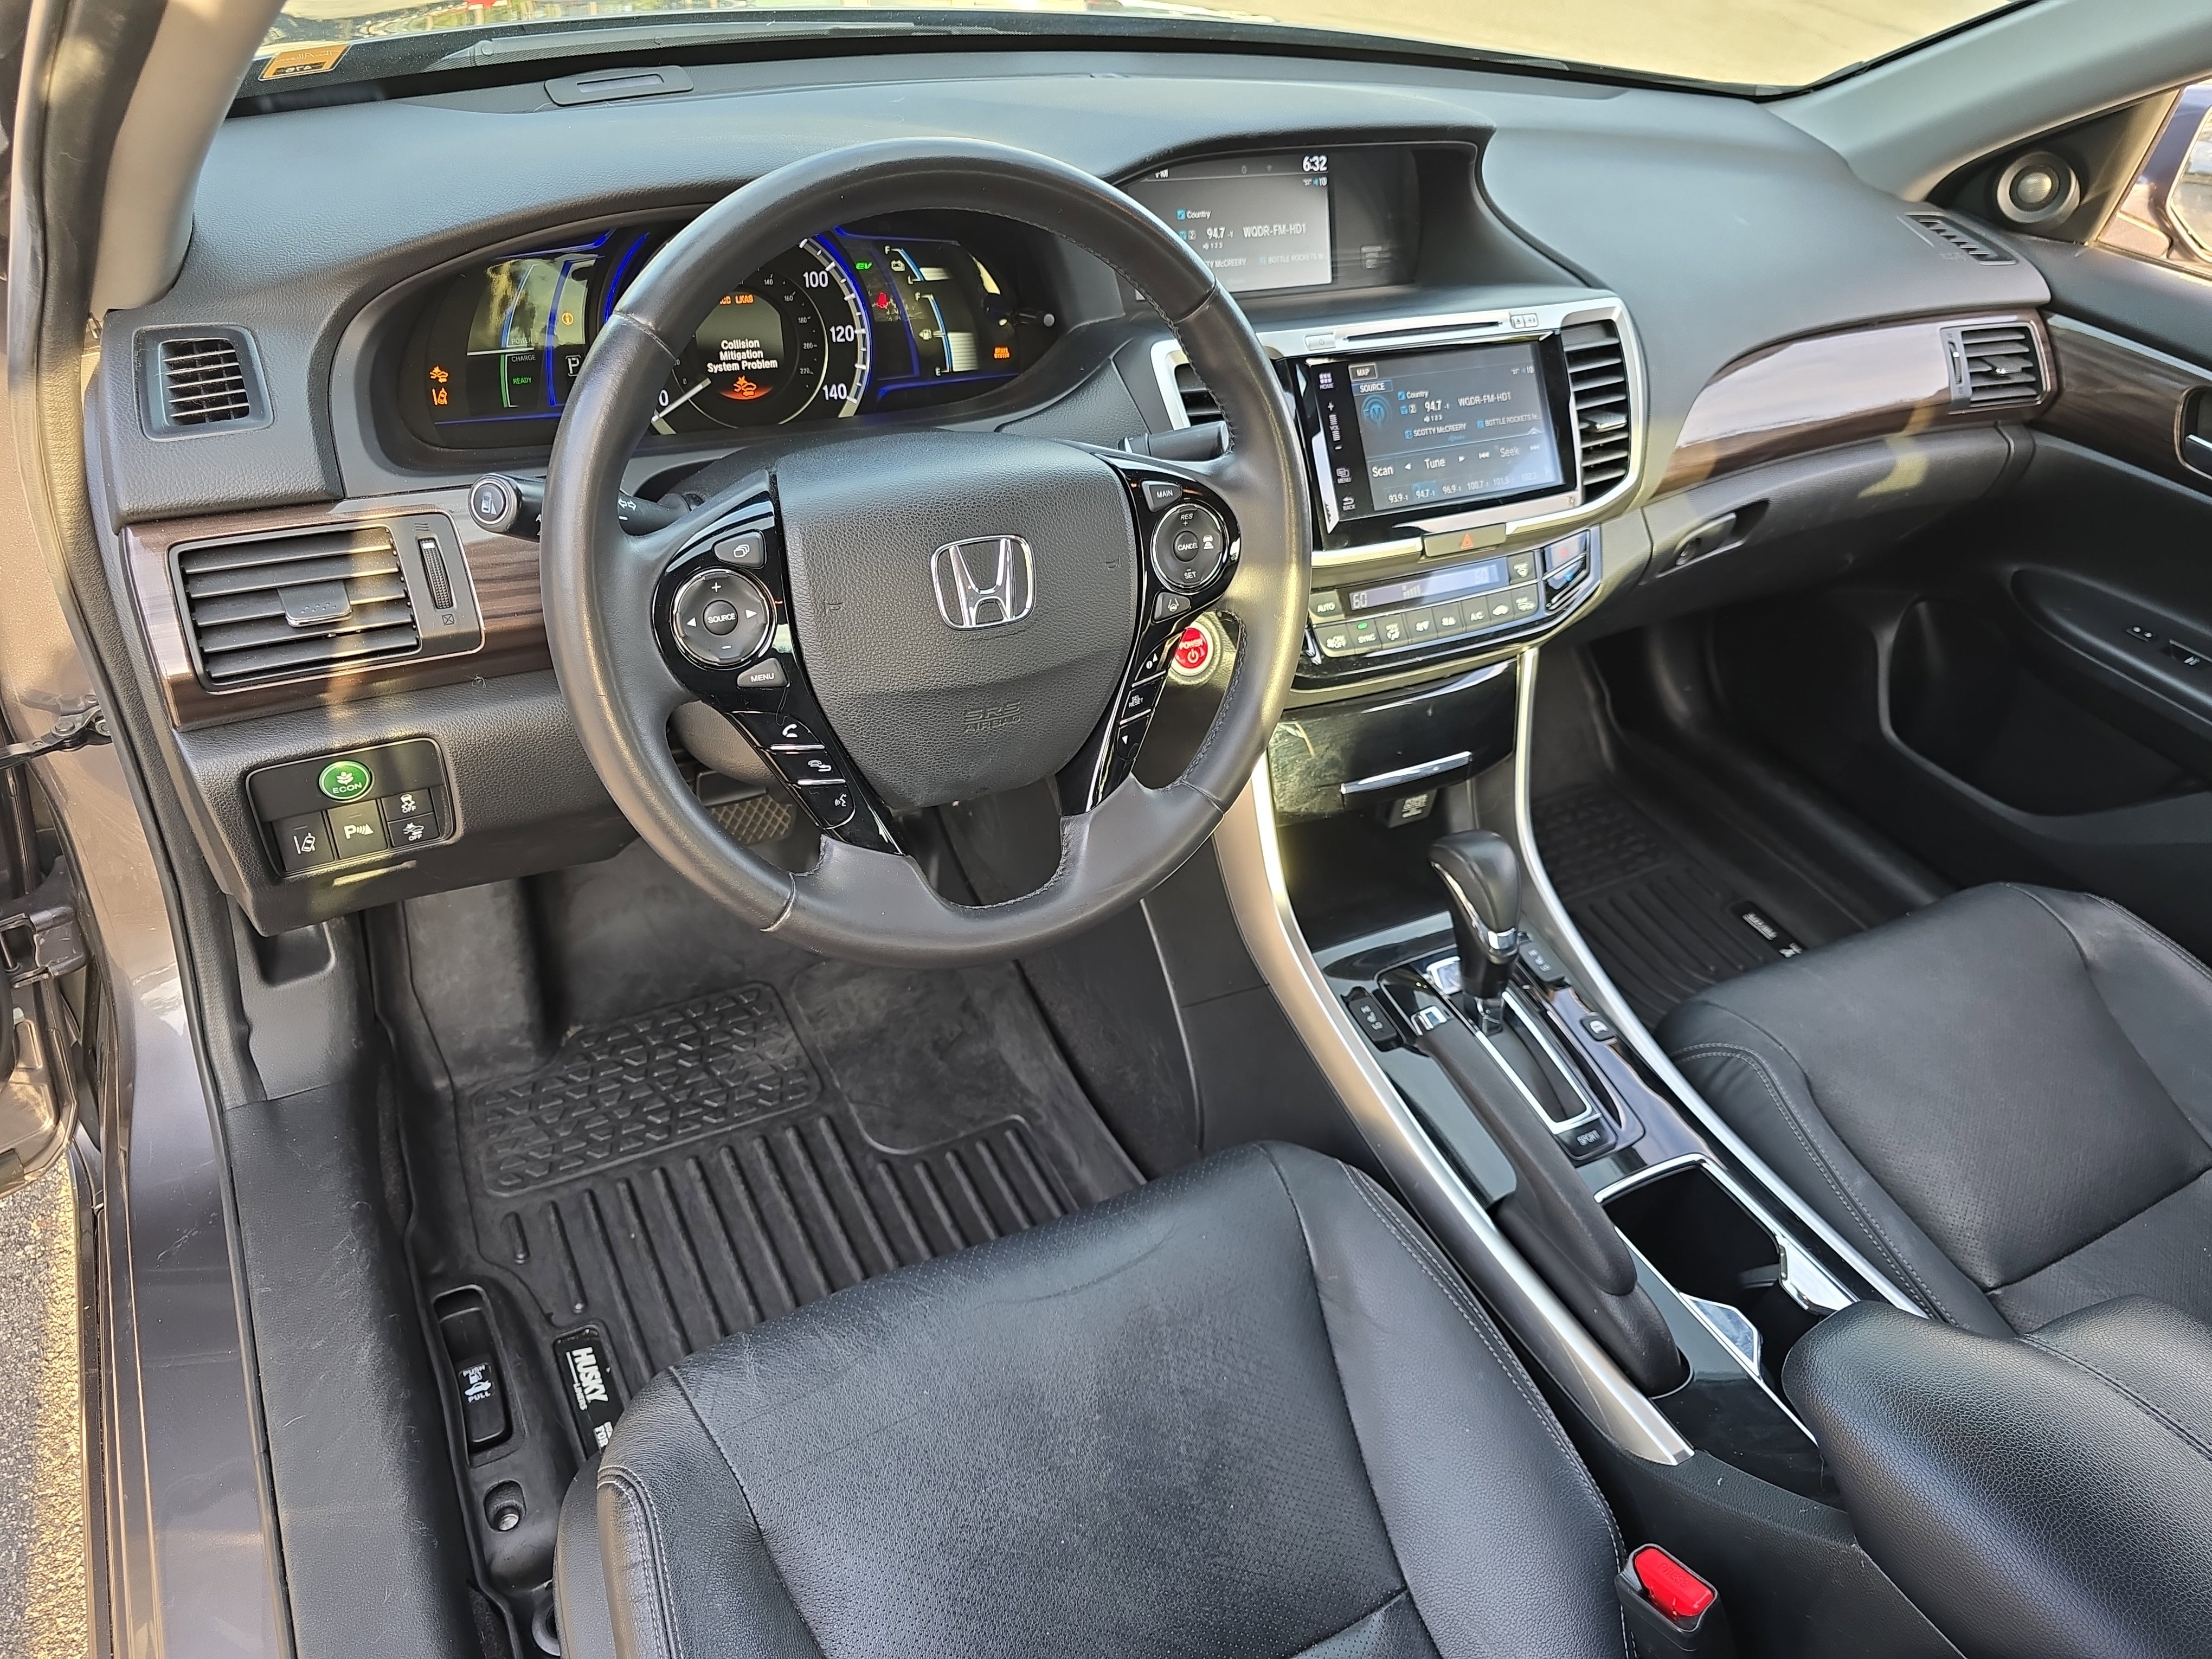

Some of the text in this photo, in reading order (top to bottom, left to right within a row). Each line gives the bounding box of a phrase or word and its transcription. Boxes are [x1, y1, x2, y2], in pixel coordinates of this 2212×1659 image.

[1302, 155, 1328, 172] 6:32
[1186, 210, 1211, 220] Country
[1206, 227, 1225, 240] 94.7
[1243, 223, 1307, 239] WQDR-FM-HD1
[803, 271, 828, 288] 100
[720, 294, 754, 305] CC LKAS
[829, 325, 854, 343] 120
[721, 339, 760, 350] Collision
[511, 355, 536, 363] CHARGE
[719, 350, 764, 362] Mitigation
[568, 357, 580, 375] P
[707, 359, 778, 374] System Problem
[1356, 369, 1371, 377] MAP
[513, 377, 532, 385] READY
[1359, 382, 1386, 393] SOURCE
[822, 383, 847, 401] 140
[1406, 390, 1429, 400] Country
[1424, 400, 1442, 413] 94.7
[1457, 391, 1511, 407] WQDR-FM-HD1
[1485, 417, 1506, 427] BOTTLE
[1506, 414, 1531, 424] ROCKETS
[1413, 423, 1467, 438] SCOTTY McCREERY
[1500, 446, 1520, 458] Seek
[1424, 457, 1446, 470] Tune
[1372, 466, 1394, 478] Scan
[1156, 490, 1173, 498] MAIN
[1178, 542, 1198, 551] CANCEL
[1184, 571, 1197, 580] SET
[1353, 592, 1368, 609] 60
[1317, 602, 1335, 613] AUTO
[708, 612, 736, 624] SOURCE
[1179, 638, 1204, 651] POWER
[1358, 633, 1377, 644] SYNC
[750, 672, 775, 683] MENU
[965, 703, 1021, 718] SRS
[963, 715, 1022, 734] AIRBAG
[332, 781, 362, 794] ECON
[402, 805, 416, 814] OFF
[344, 824, 356, 840] P
[408, 833, 423, 841] OFF
[462, 1364, 486, 1378] PUSH
[571, 1347, 609, 1403] HUSKY
[467, 1391, 491, 1404] PULL
[1657, 1561, 1689, 1589] PRESS
